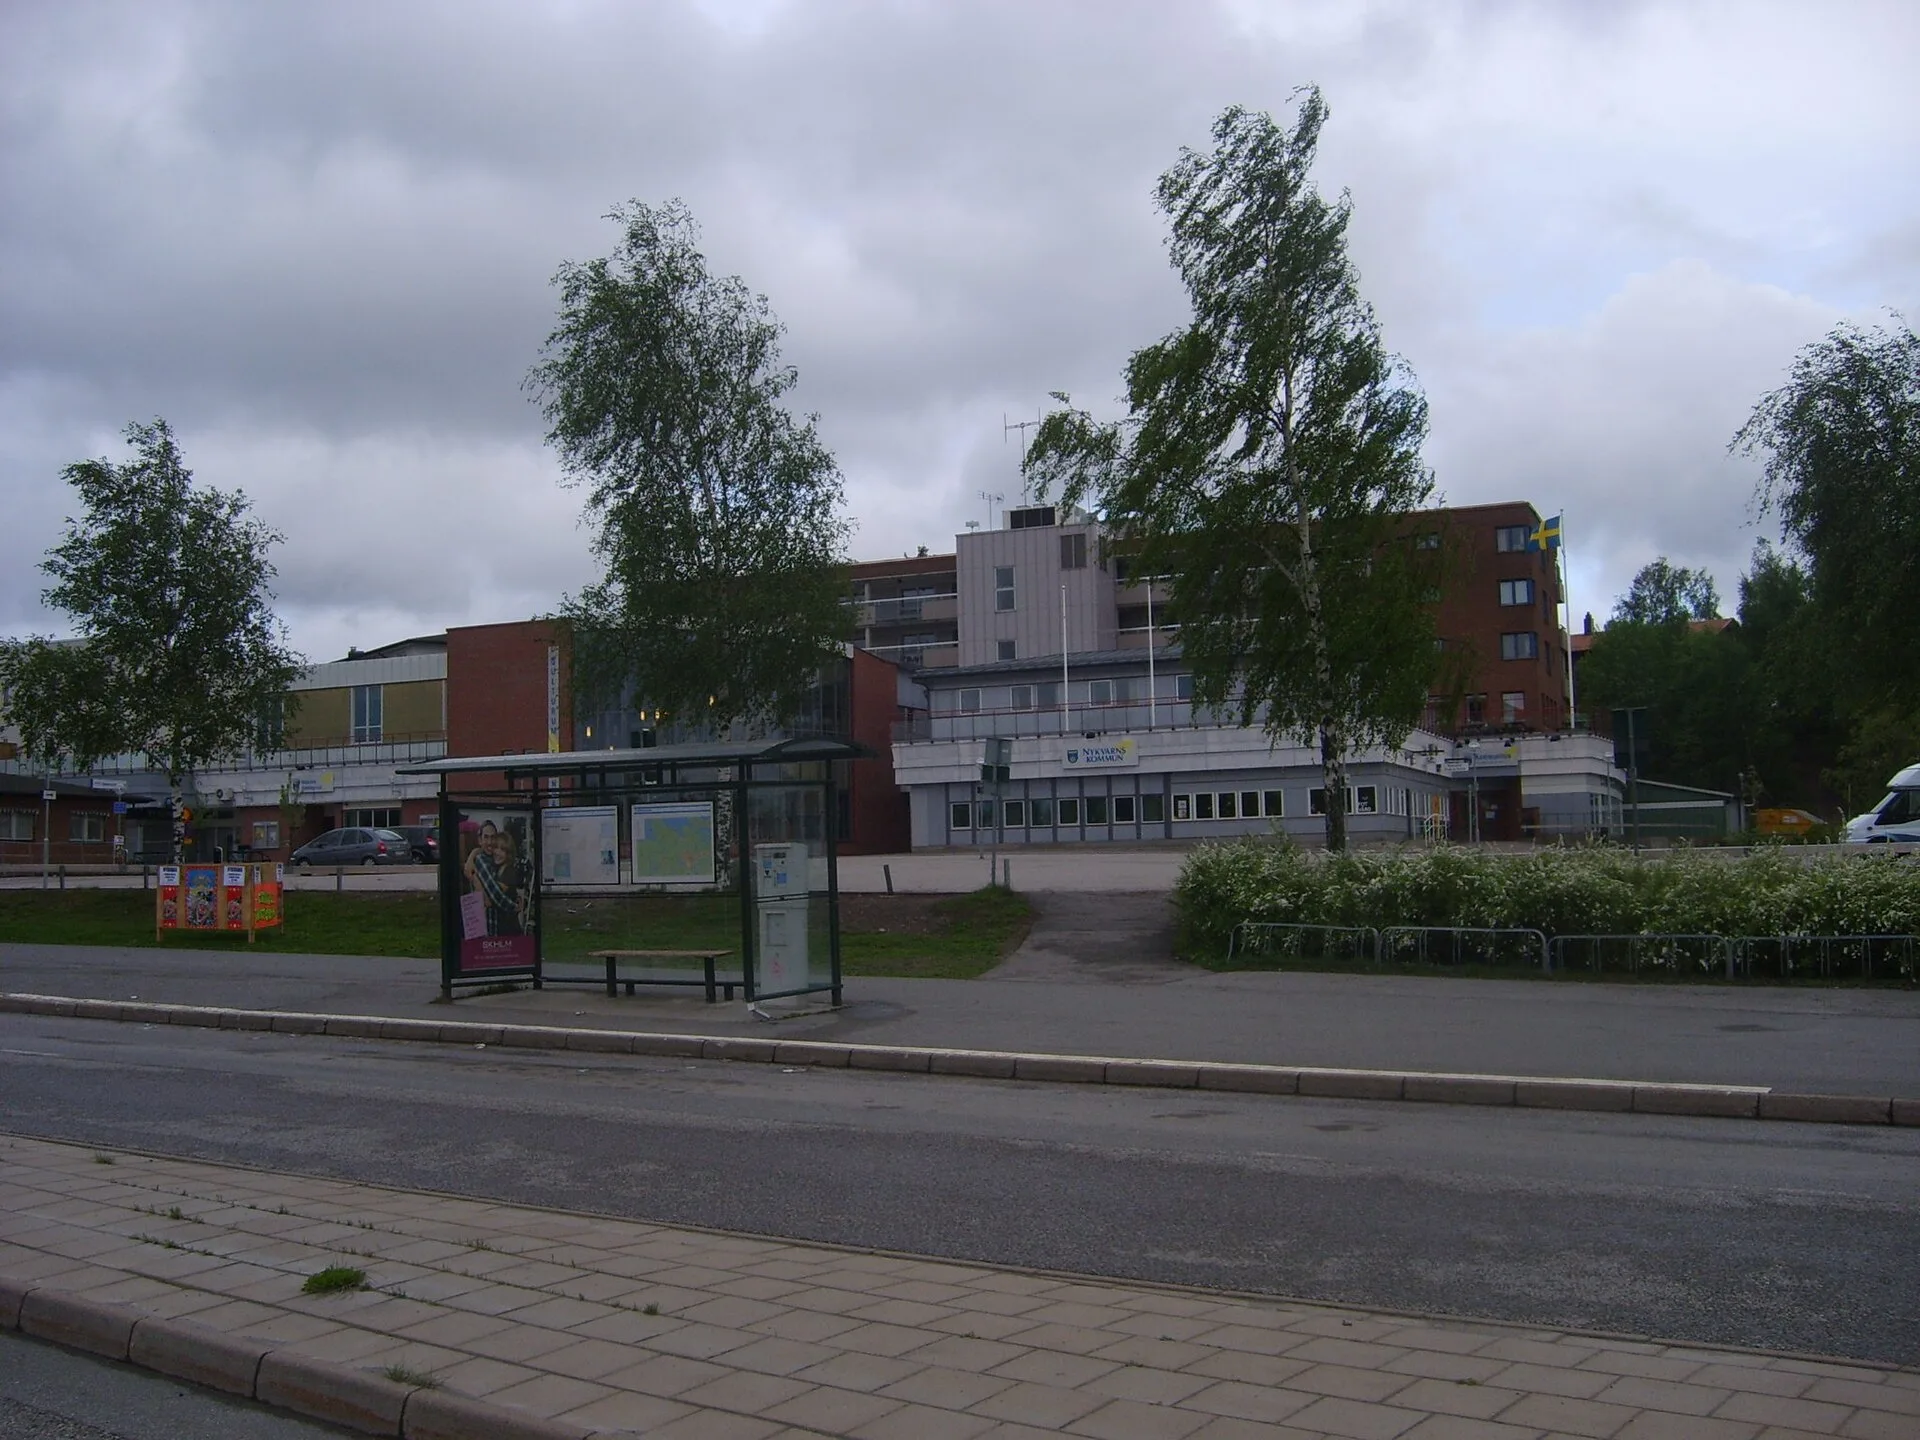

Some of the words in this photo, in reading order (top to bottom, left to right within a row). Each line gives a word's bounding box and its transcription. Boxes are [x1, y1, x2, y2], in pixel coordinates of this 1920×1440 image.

[1082, 746, 1127, 756] NYKVARNS
[1086, 754, 1124, 763] KOMMUN
[482, 940, 512, 949] SKHLM
